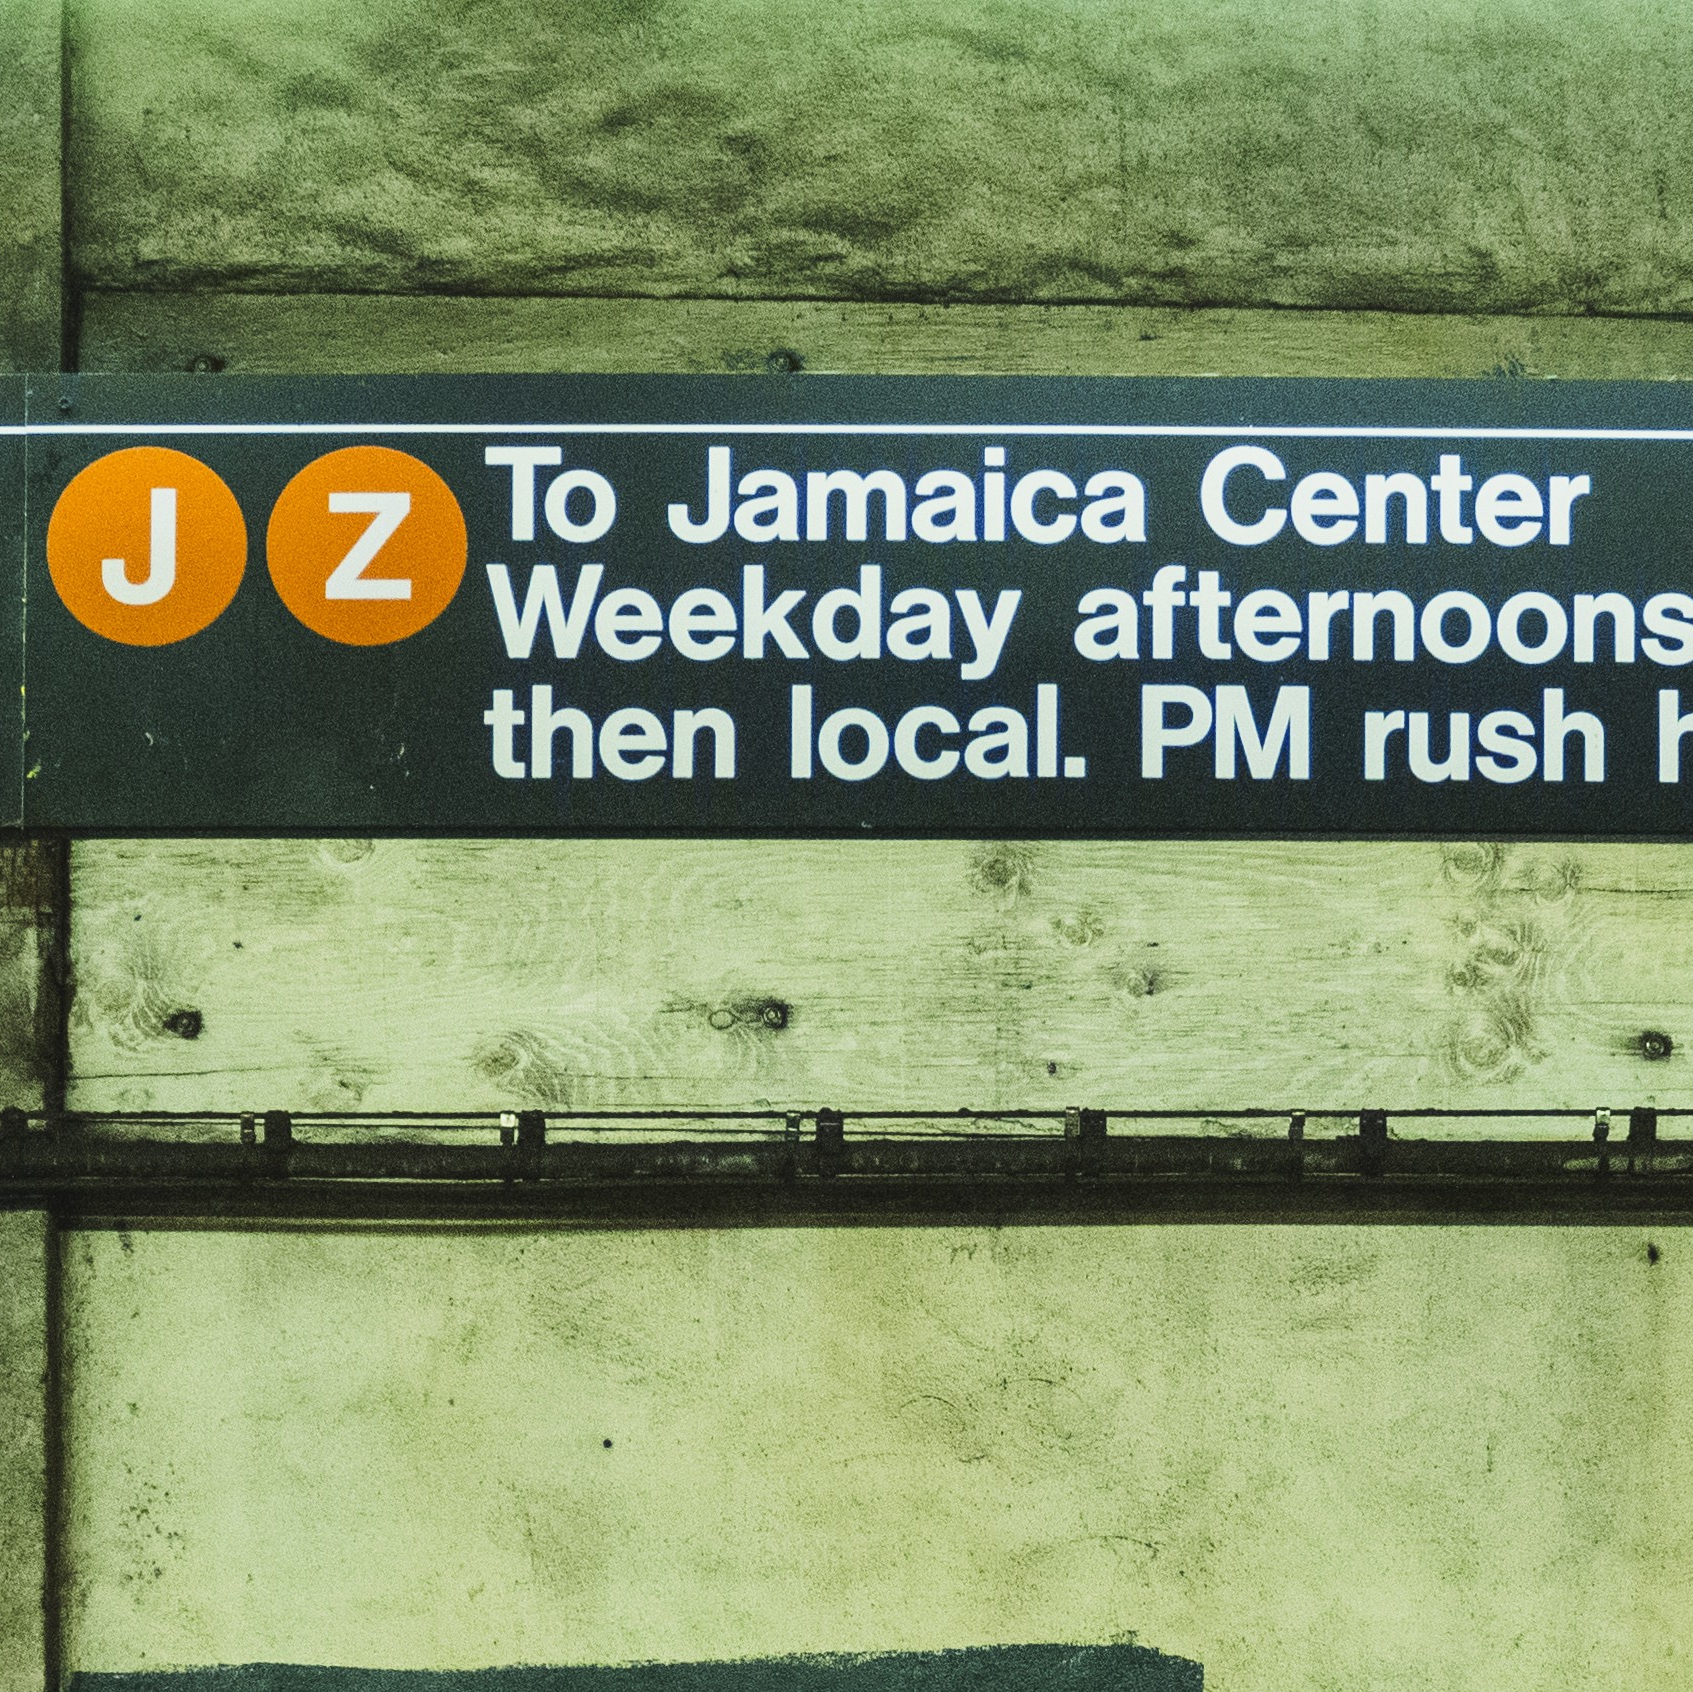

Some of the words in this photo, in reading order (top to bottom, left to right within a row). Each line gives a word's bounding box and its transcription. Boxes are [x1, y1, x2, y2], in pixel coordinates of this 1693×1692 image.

[101, 487, 177, 606] J
[325, 491, 412, 601] Z
[484, 445, 617, 544] To
[667, 445, 1147, 545] Jamaica
[1200, 444, 1591, 548] Center
[485, 563, 1023, 681] Weekday
[483, 684, 736, 781] then
[790, 683, 1086, 781] local.
[1141, 684, 1310, 780] PM
[1364, 687, 1605, 784] rush
